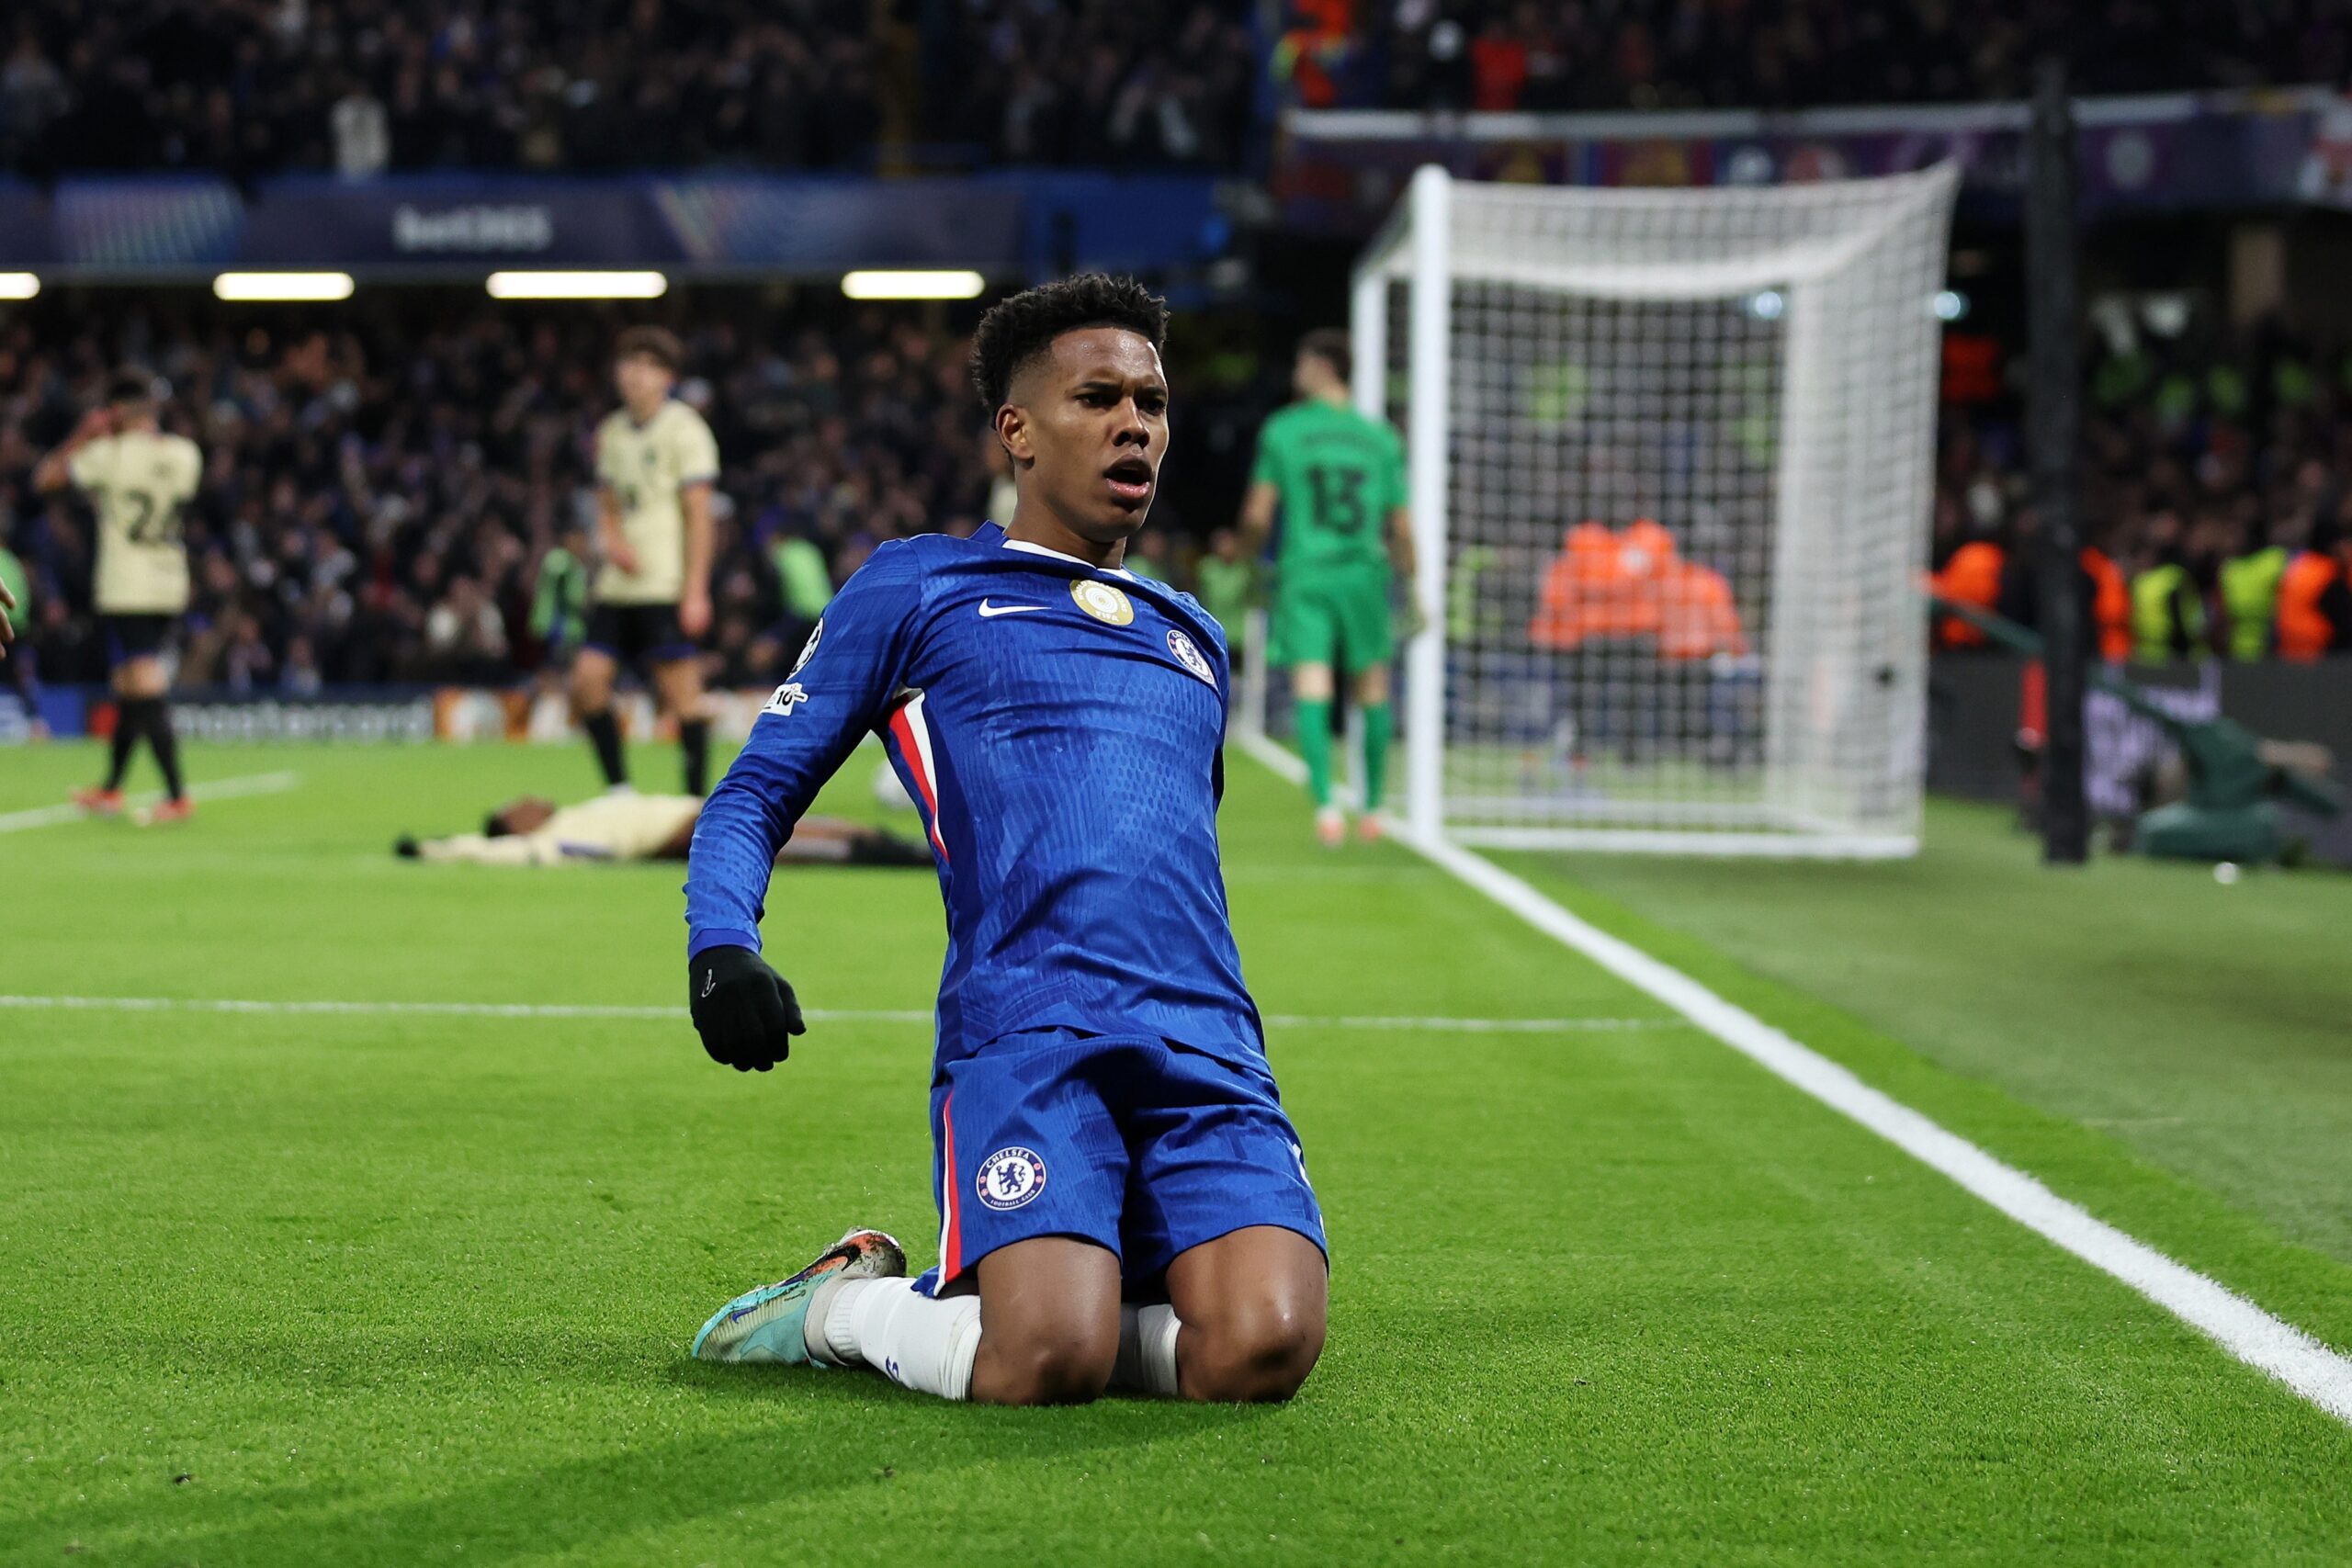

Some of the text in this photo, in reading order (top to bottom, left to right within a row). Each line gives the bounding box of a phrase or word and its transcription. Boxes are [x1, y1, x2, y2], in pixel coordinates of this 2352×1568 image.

[1309, 463, 1368, 536] 13
[776, 690, 793, 706] 10
[986, 1149, 1030, 1168] CHELSEA
